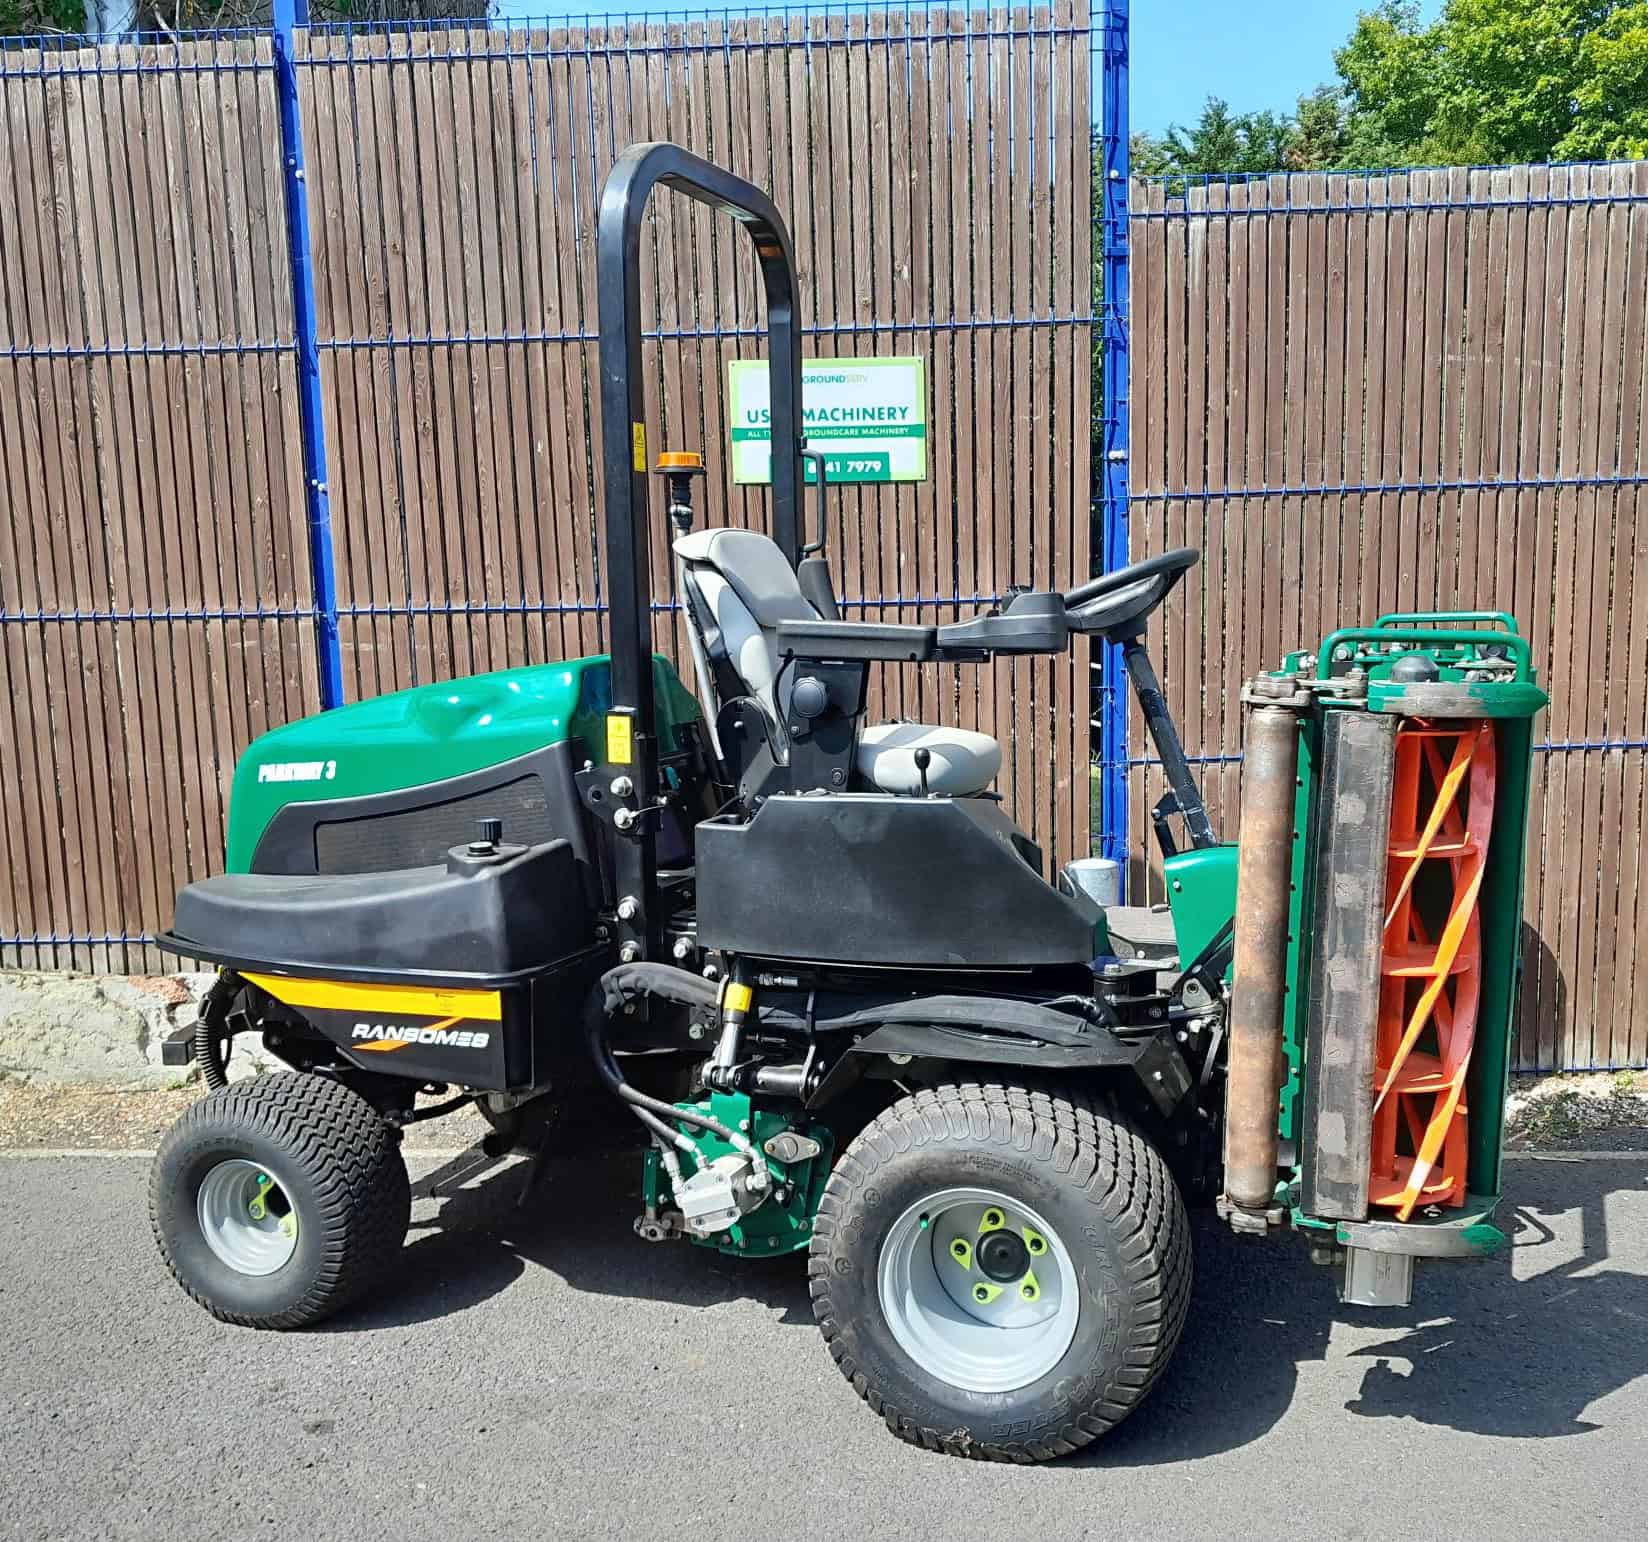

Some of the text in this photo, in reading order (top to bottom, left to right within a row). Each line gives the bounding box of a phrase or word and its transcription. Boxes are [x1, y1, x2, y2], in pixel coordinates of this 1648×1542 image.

[803, 406, 909, 423] MACHINERY
[862, 427, 909, 436] MACHINERY
[846, 460, 883, 473] 7979
[325, 760, 337, 780] 3
[351, 1023, 490, 1049] RANSOMES
